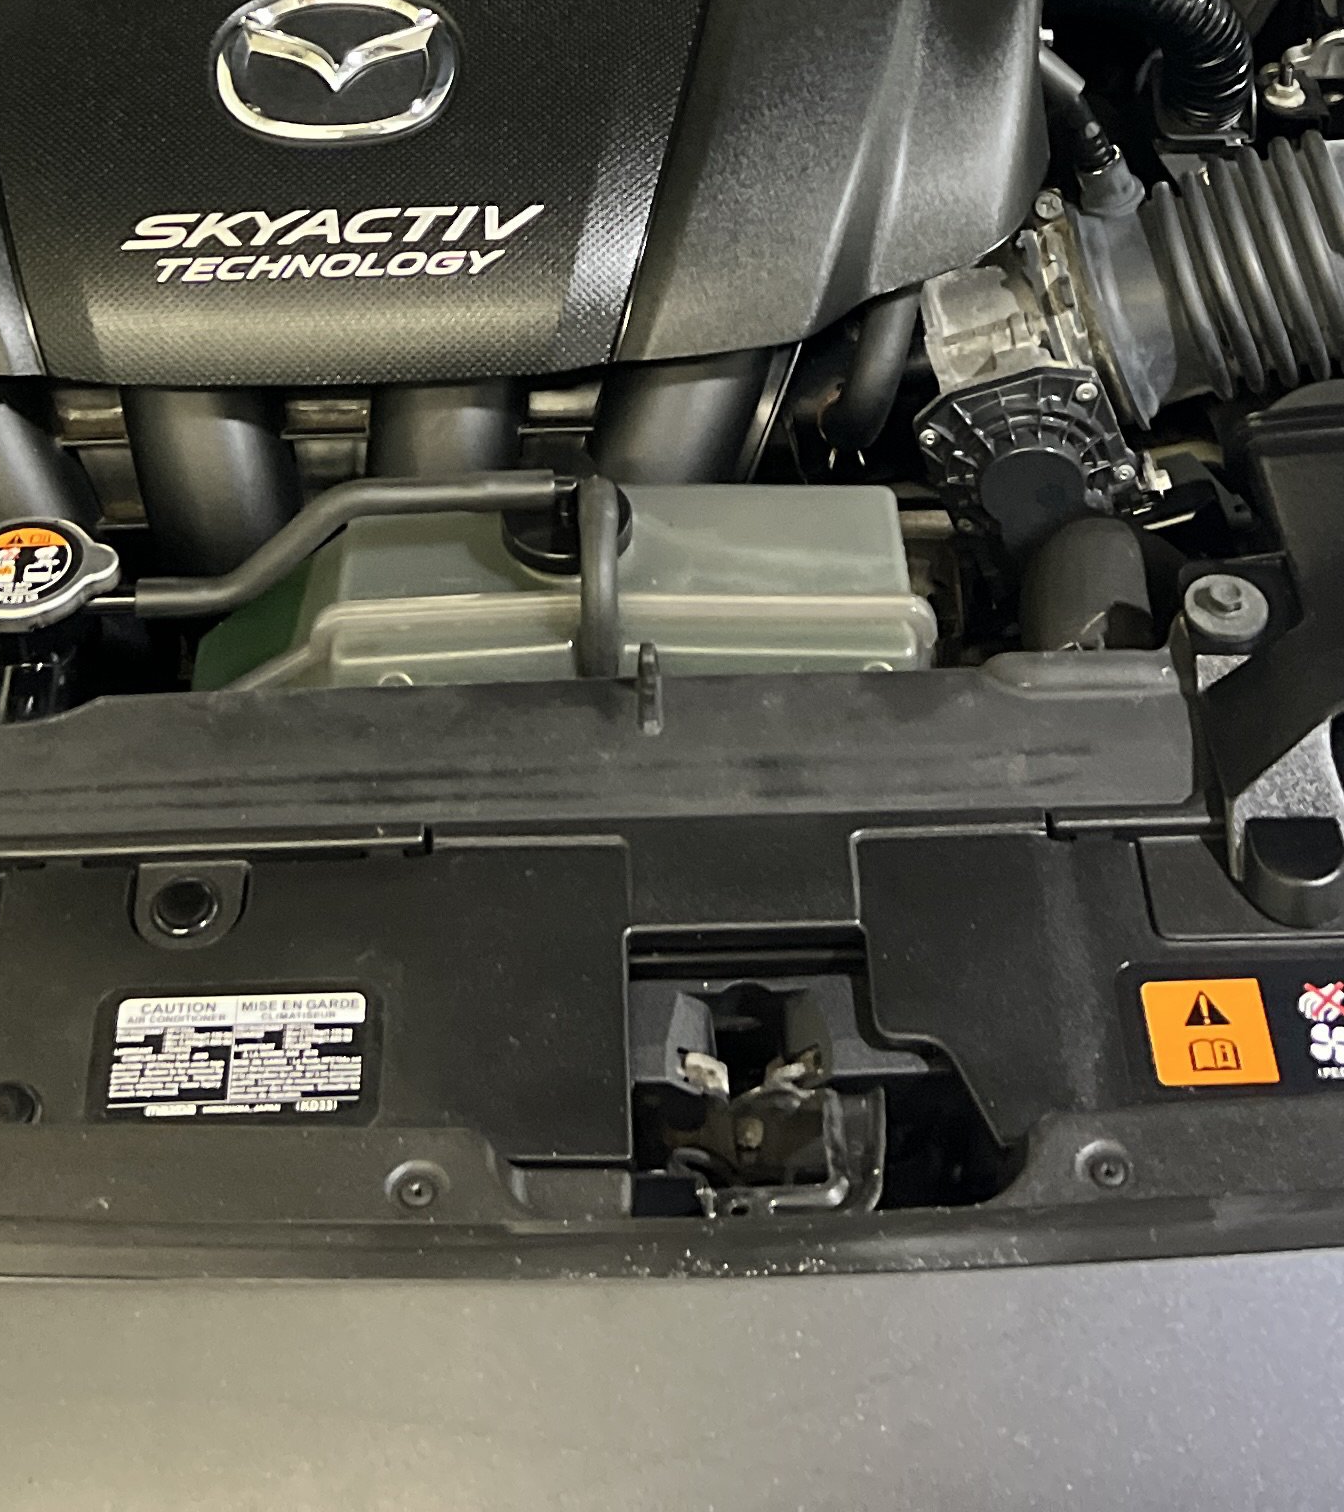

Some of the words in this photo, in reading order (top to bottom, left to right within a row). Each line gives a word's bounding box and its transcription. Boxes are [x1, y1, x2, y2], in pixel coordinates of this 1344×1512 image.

[120, 203, 546, 251] SKYACTIV
[156, 248, 507, 284] TECHNOLOGY
[140, 1001, 217, 1015] CAUTION
[241, 1000, 278, 1012] MISE
[282, 999, 302, 1011] EN
[305, 997, 360, 1011] GARDE
[127, 1015, 146, 1024] AIR
[148, 1013, 227, 1024] CONDITIONER
